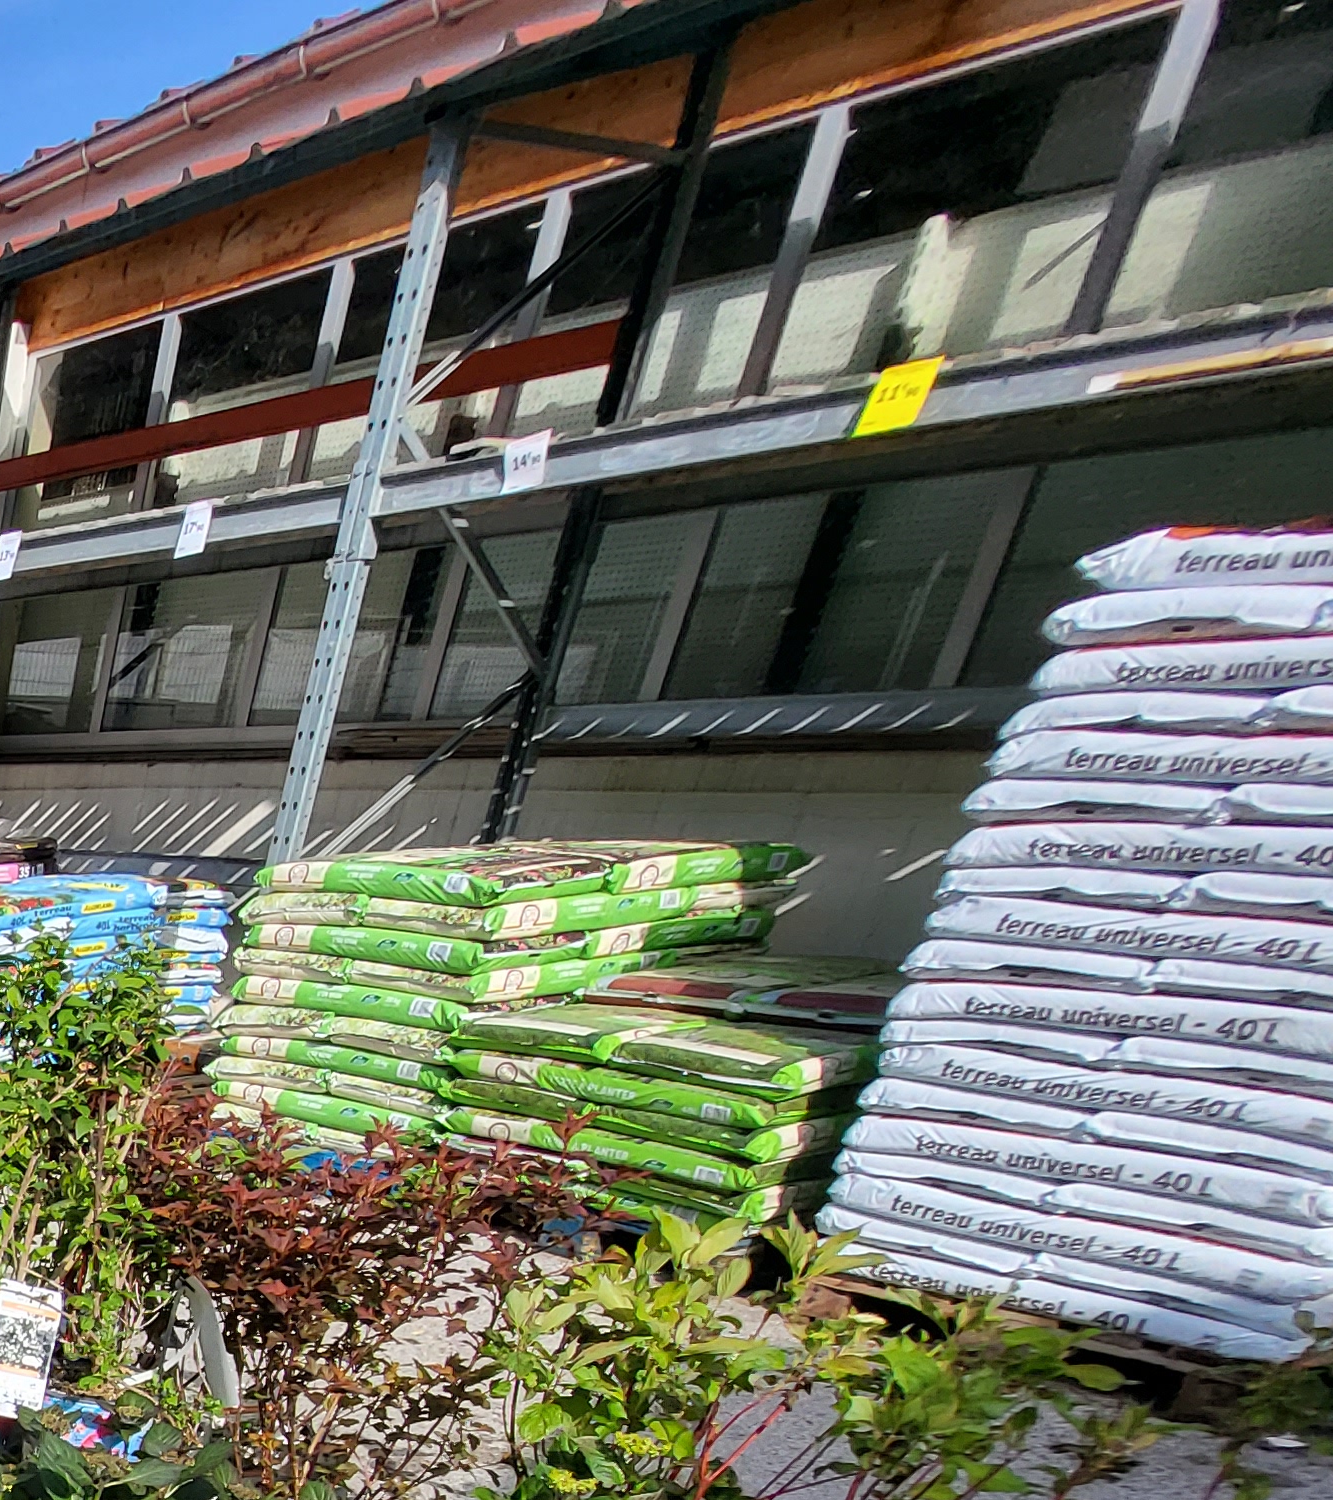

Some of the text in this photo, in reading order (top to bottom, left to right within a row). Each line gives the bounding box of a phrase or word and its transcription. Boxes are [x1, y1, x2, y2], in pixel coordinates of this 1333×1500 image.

[1175, 549, 1282, 574] terreau
[1064, 746, 1160, 773] terreau
[1169, 752, 1310, 776] universel
[1134, 842, 1258, 866] universel
[996, 913, 1086, 941] terreau
[1096, 921, 1224, 952] universel
[965, 996, 1053, 1023] terreau
[1061, 1006, 1184, 1034] universel
[941, 1058, 1024, 1090] terreau
[1033, 1078, 1153, 1110] universel
[1006, 1152, 1125, 1183] universel
[891, 1194, 971, 1233] terreau
[979, 1218, 1098, 1256] universel
